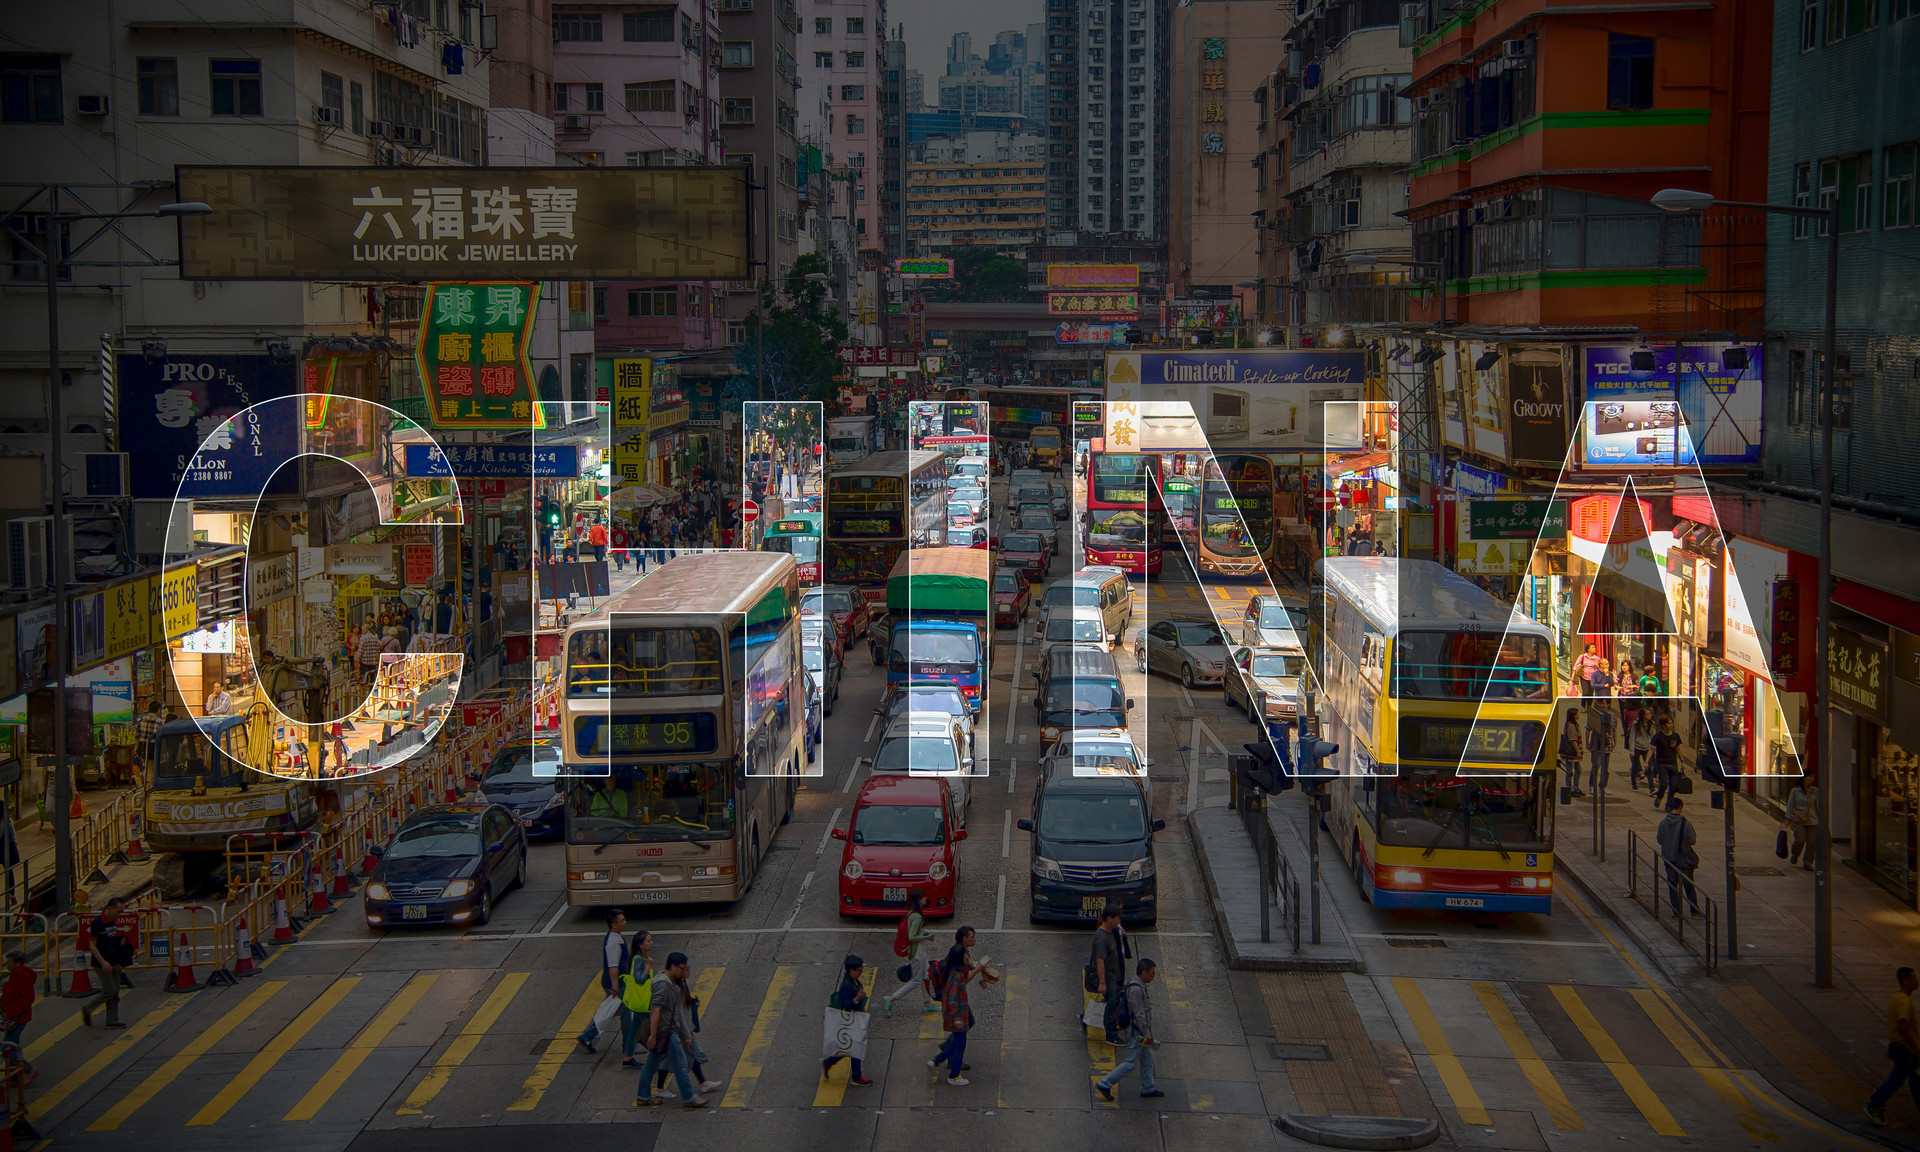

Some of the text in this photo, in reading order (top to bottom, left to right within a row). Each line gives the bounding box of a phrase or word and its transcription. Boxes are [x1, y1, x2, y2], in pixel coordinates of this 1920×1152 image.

[352, 186, 578, 240] 六福珠寶
[353, 244, 578, 262] LUKFOOK JEWELLERY
[434, 286, 525, 327] 東昇
[436, 332, 516, 363] 廚櫃
[438, 365, 516, 397] 瓷磚
[1163, 359, 1236, 382] Cimatech
[1303, 364, 1351, 384] Cooking
[440, 400, 531, 420] 請上一樓
[193, 472, 213, 482] 2380
[214, 471, 233, 481] 8807
[427, 464, 448, 474] Sun
[476, 463, 517, 474] Kitchen
[181, 574, 196, 607] 168
[1459, 623, 1481, 631] 2249
[1861, 689, 1877, 710] HOUSE
[664, 722, 690, 744] 95
[1484, 729, 1516, 752] E21
[646, 892, 668, 900] 5403
[81, 916, 137, 925] PEIANS
